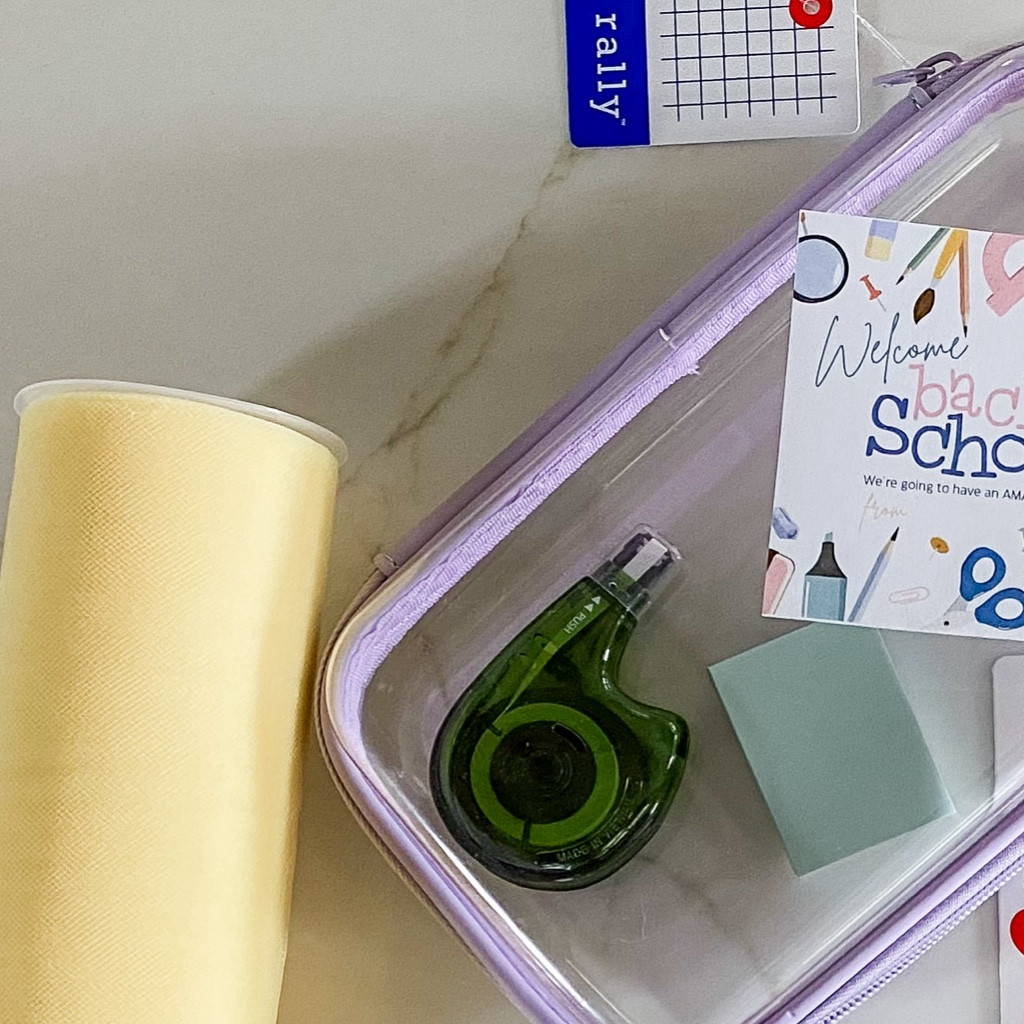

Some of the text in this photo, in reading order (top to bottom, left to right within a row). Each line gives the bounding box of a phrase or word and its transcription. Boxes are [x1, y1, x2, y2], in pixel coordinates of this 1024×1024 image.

[589, 13, 627, 120] rally
[815, 312, 969, 387] Welcome
[863, 475, 898, 488] We're
[901, 479, 933, 494] going
[937, 483, 950, 494] to
[952, 484, 982, 498] have
[984, 489, 999, 499] an
[563, 611, 587, 634] PUSH
